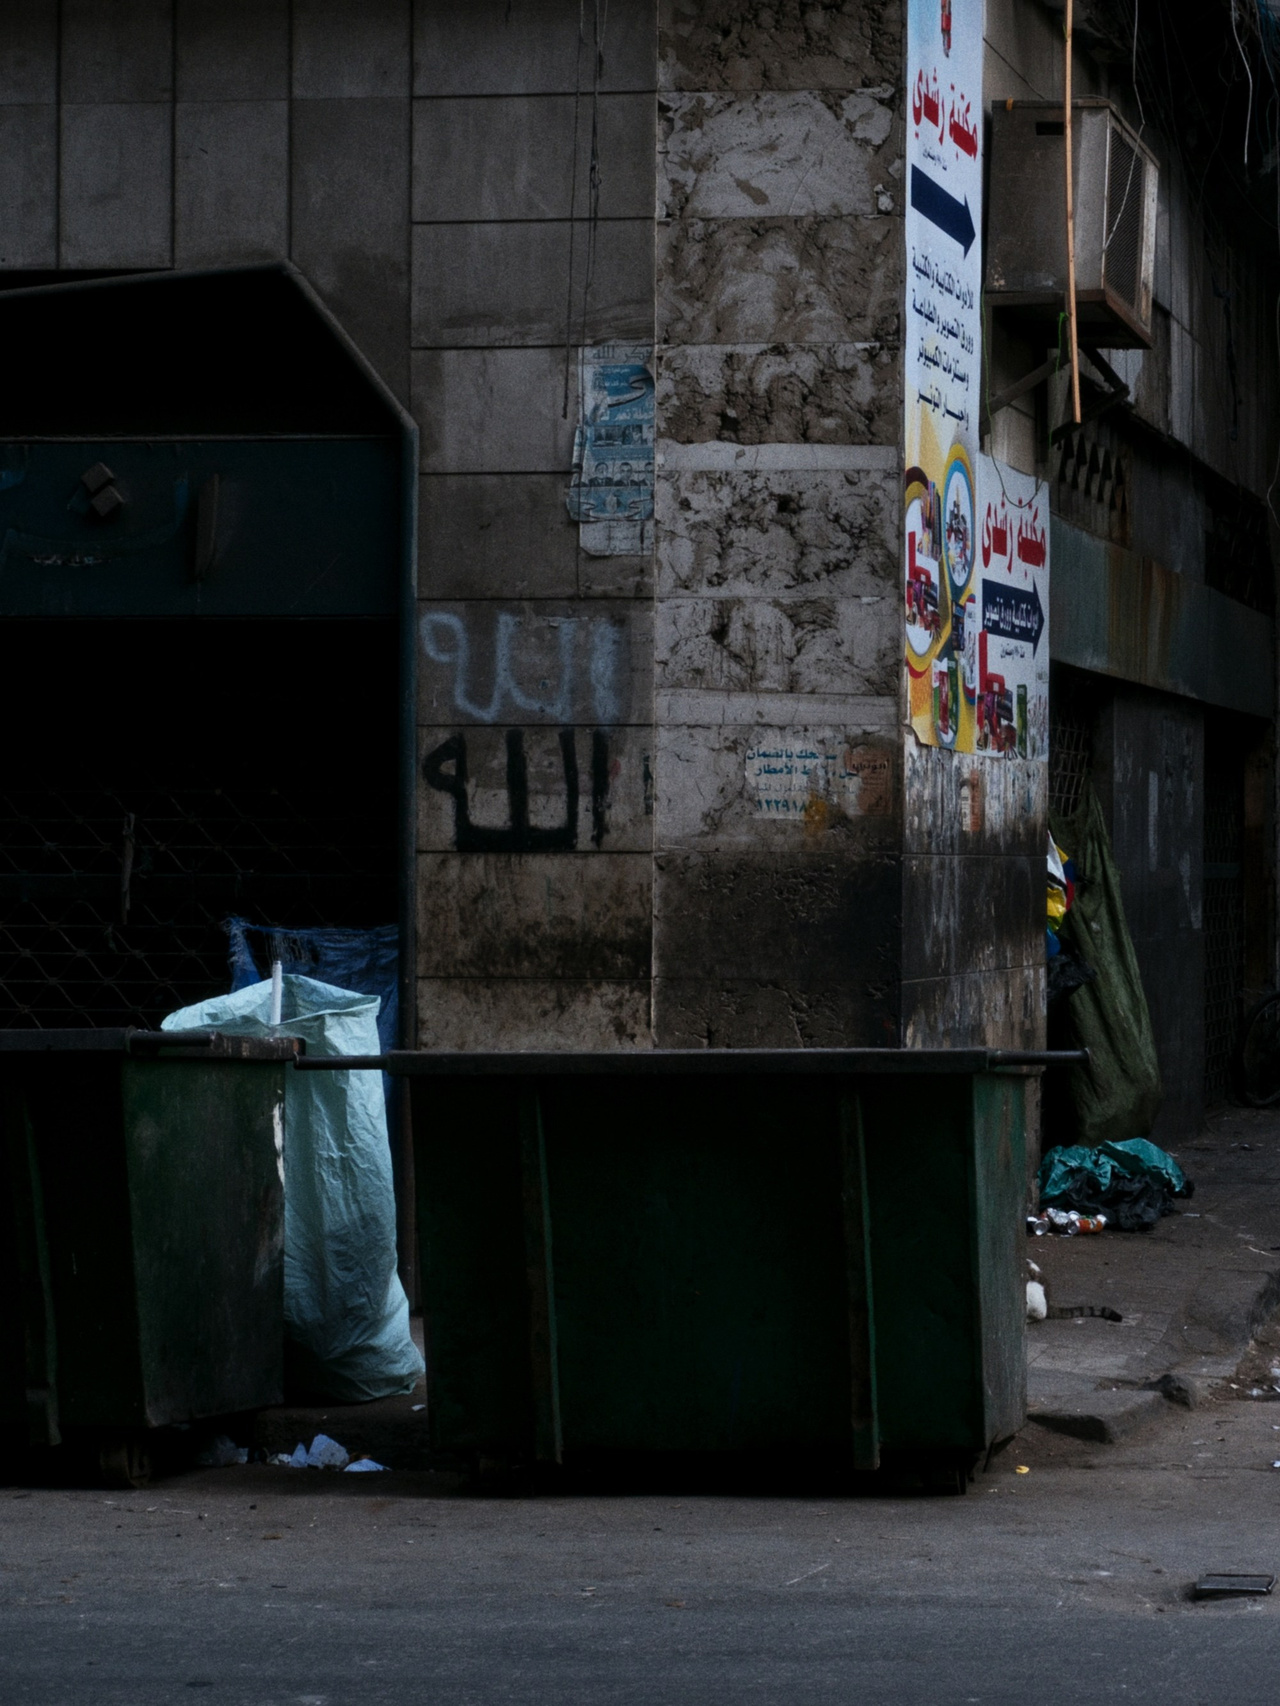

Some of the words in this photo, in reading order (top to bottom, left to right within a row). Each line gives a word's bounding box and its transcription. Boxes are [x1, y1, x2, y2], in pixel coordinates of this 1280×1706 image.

[949, 82, 978, 162] مكتبة
[1018, 497, 1046, 580] مكتبة
[422, 728, 610, 853] الله
[747, 746, 793, 761] بالضمان
